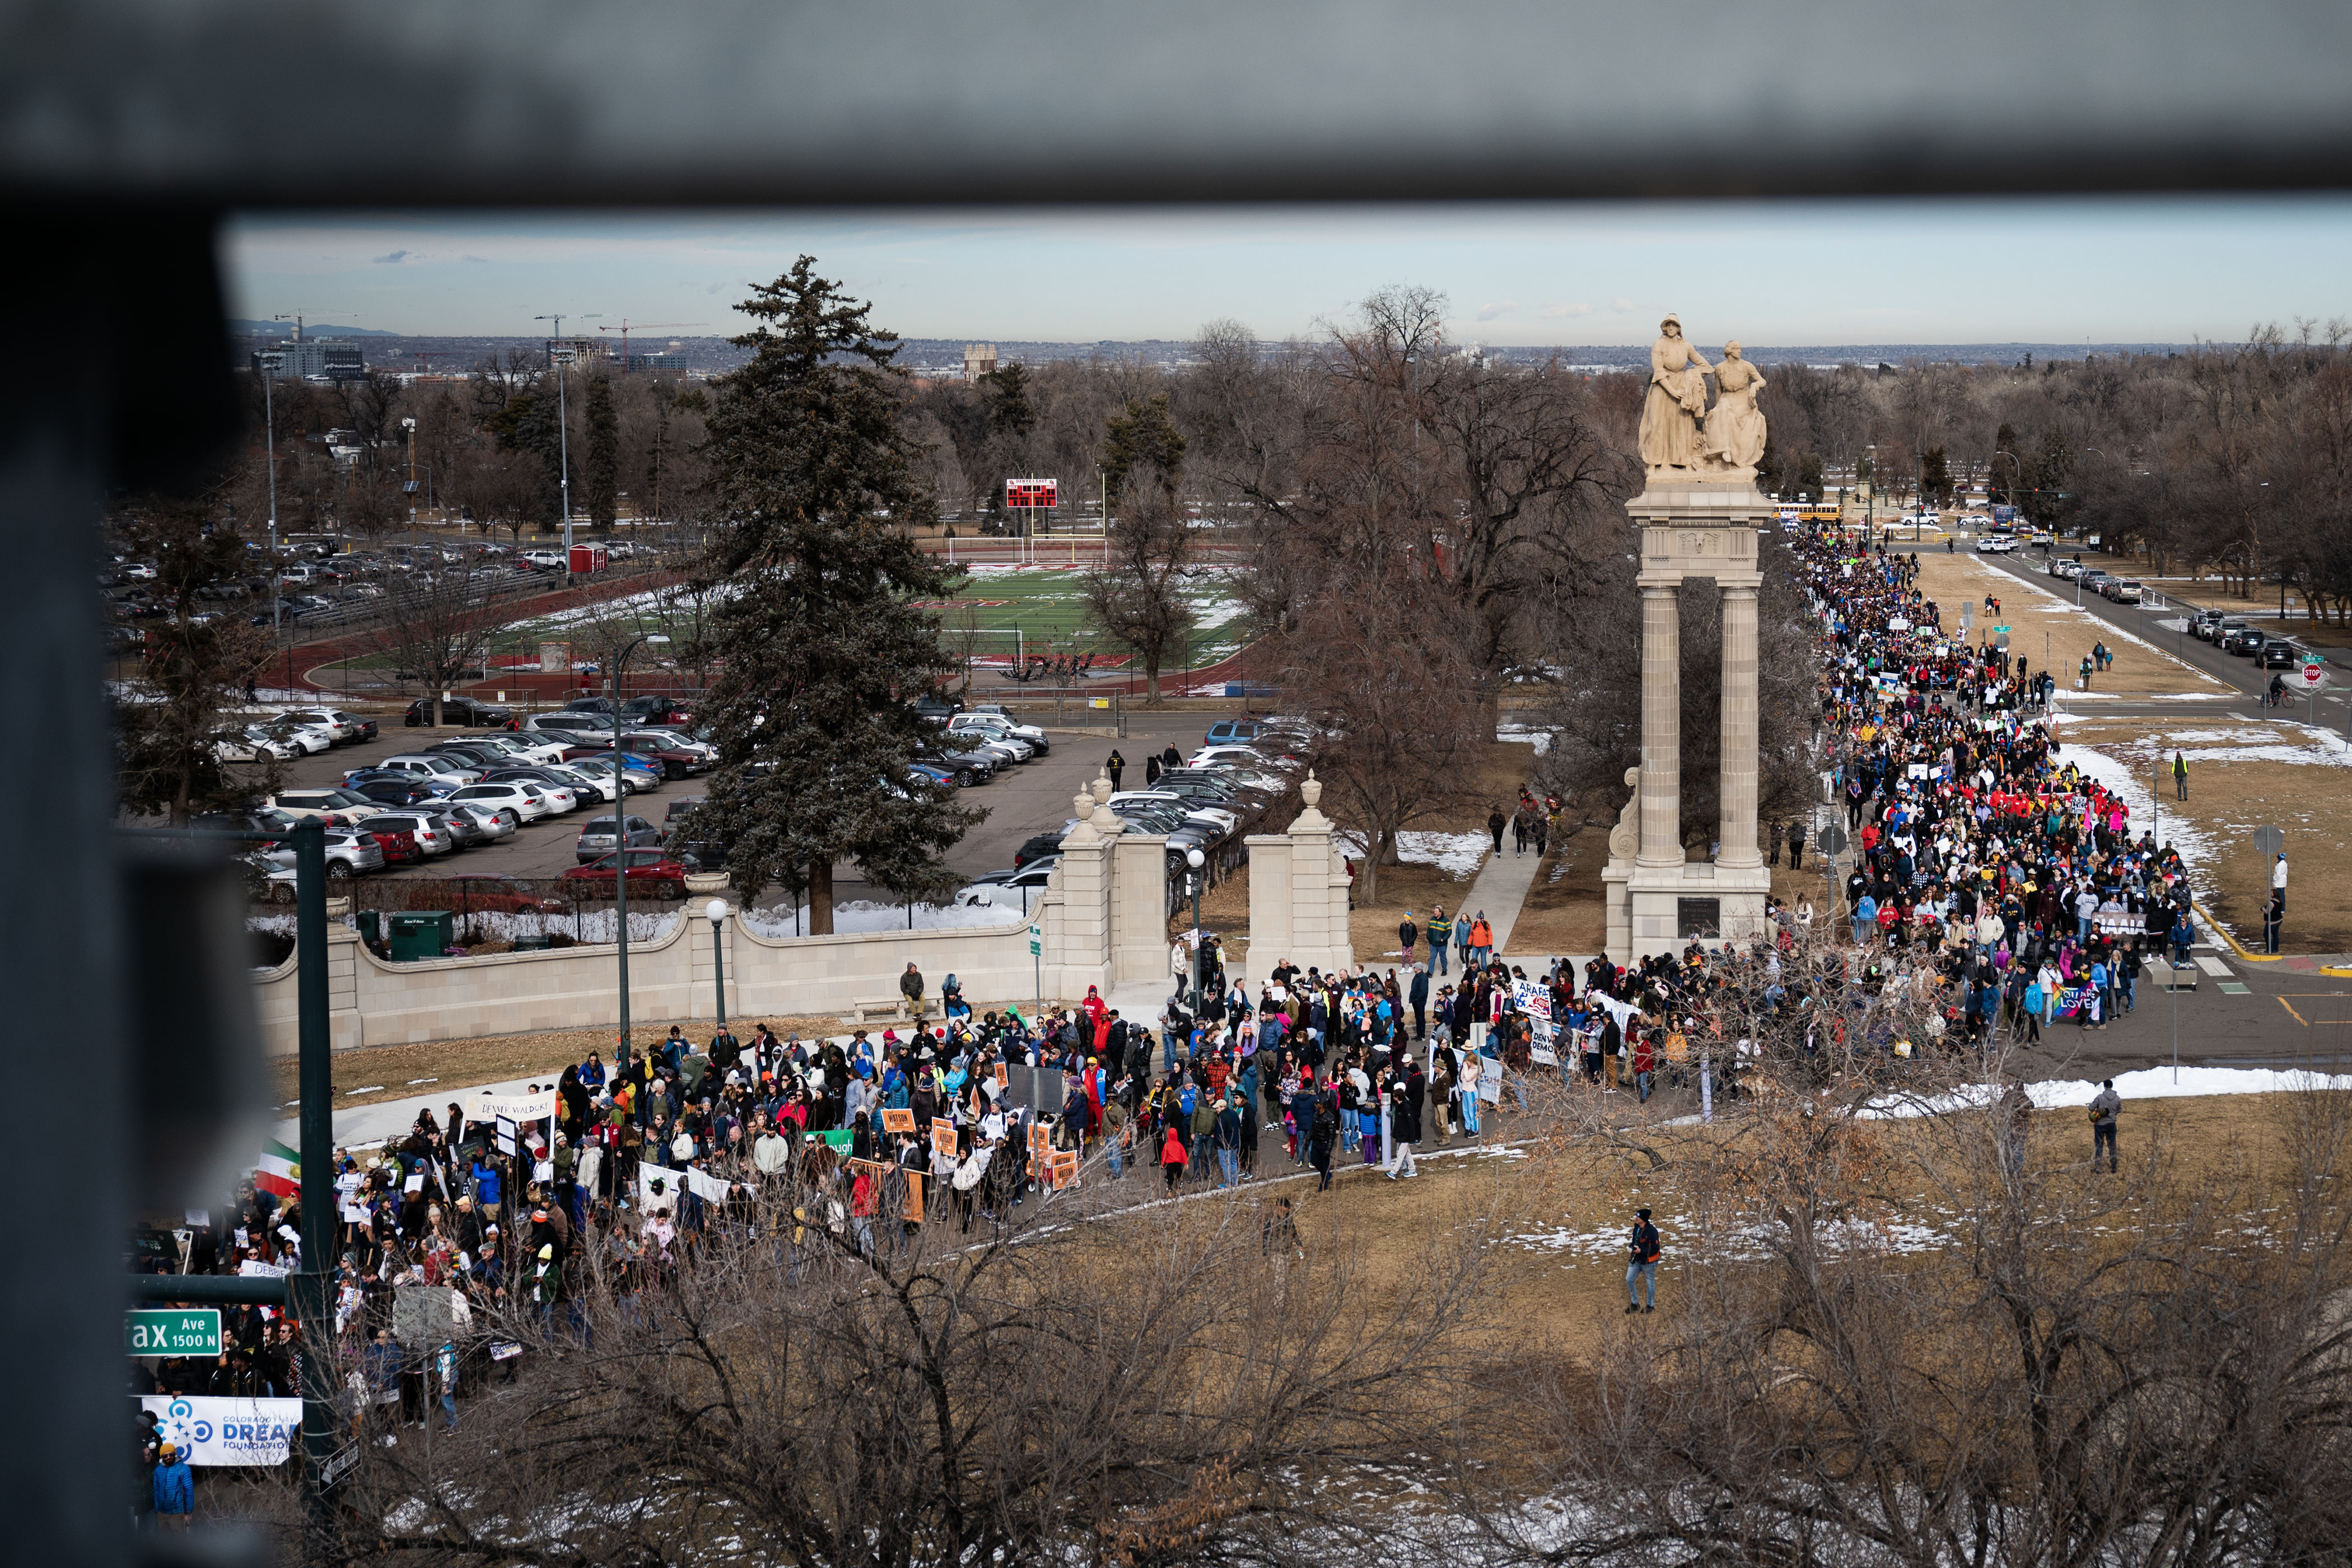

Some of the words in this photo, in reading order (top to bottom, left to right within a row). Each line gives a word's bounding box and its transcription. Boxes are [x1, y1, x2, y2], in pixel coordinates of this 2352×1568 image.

[1533, 1033, 1551, 1043] DENV
[1533, 1042, 1554, 1053] DEMO
[512, 1102, 548, 1114] WALDORF
[888, 1114, 908, 1123] WATSON
[939, 1133, 953, 1145] WATSON
[1058, 1167, 1074, 1179] WATSON
[255, 1264, 286, 1277] DEBBIE
[181, 1318, 206, 1331] Ave
[132, 1325, 168, 1348] ax
[172, 1334, 203, 1347] 1500
[207, 1335, 216, 1347] N
